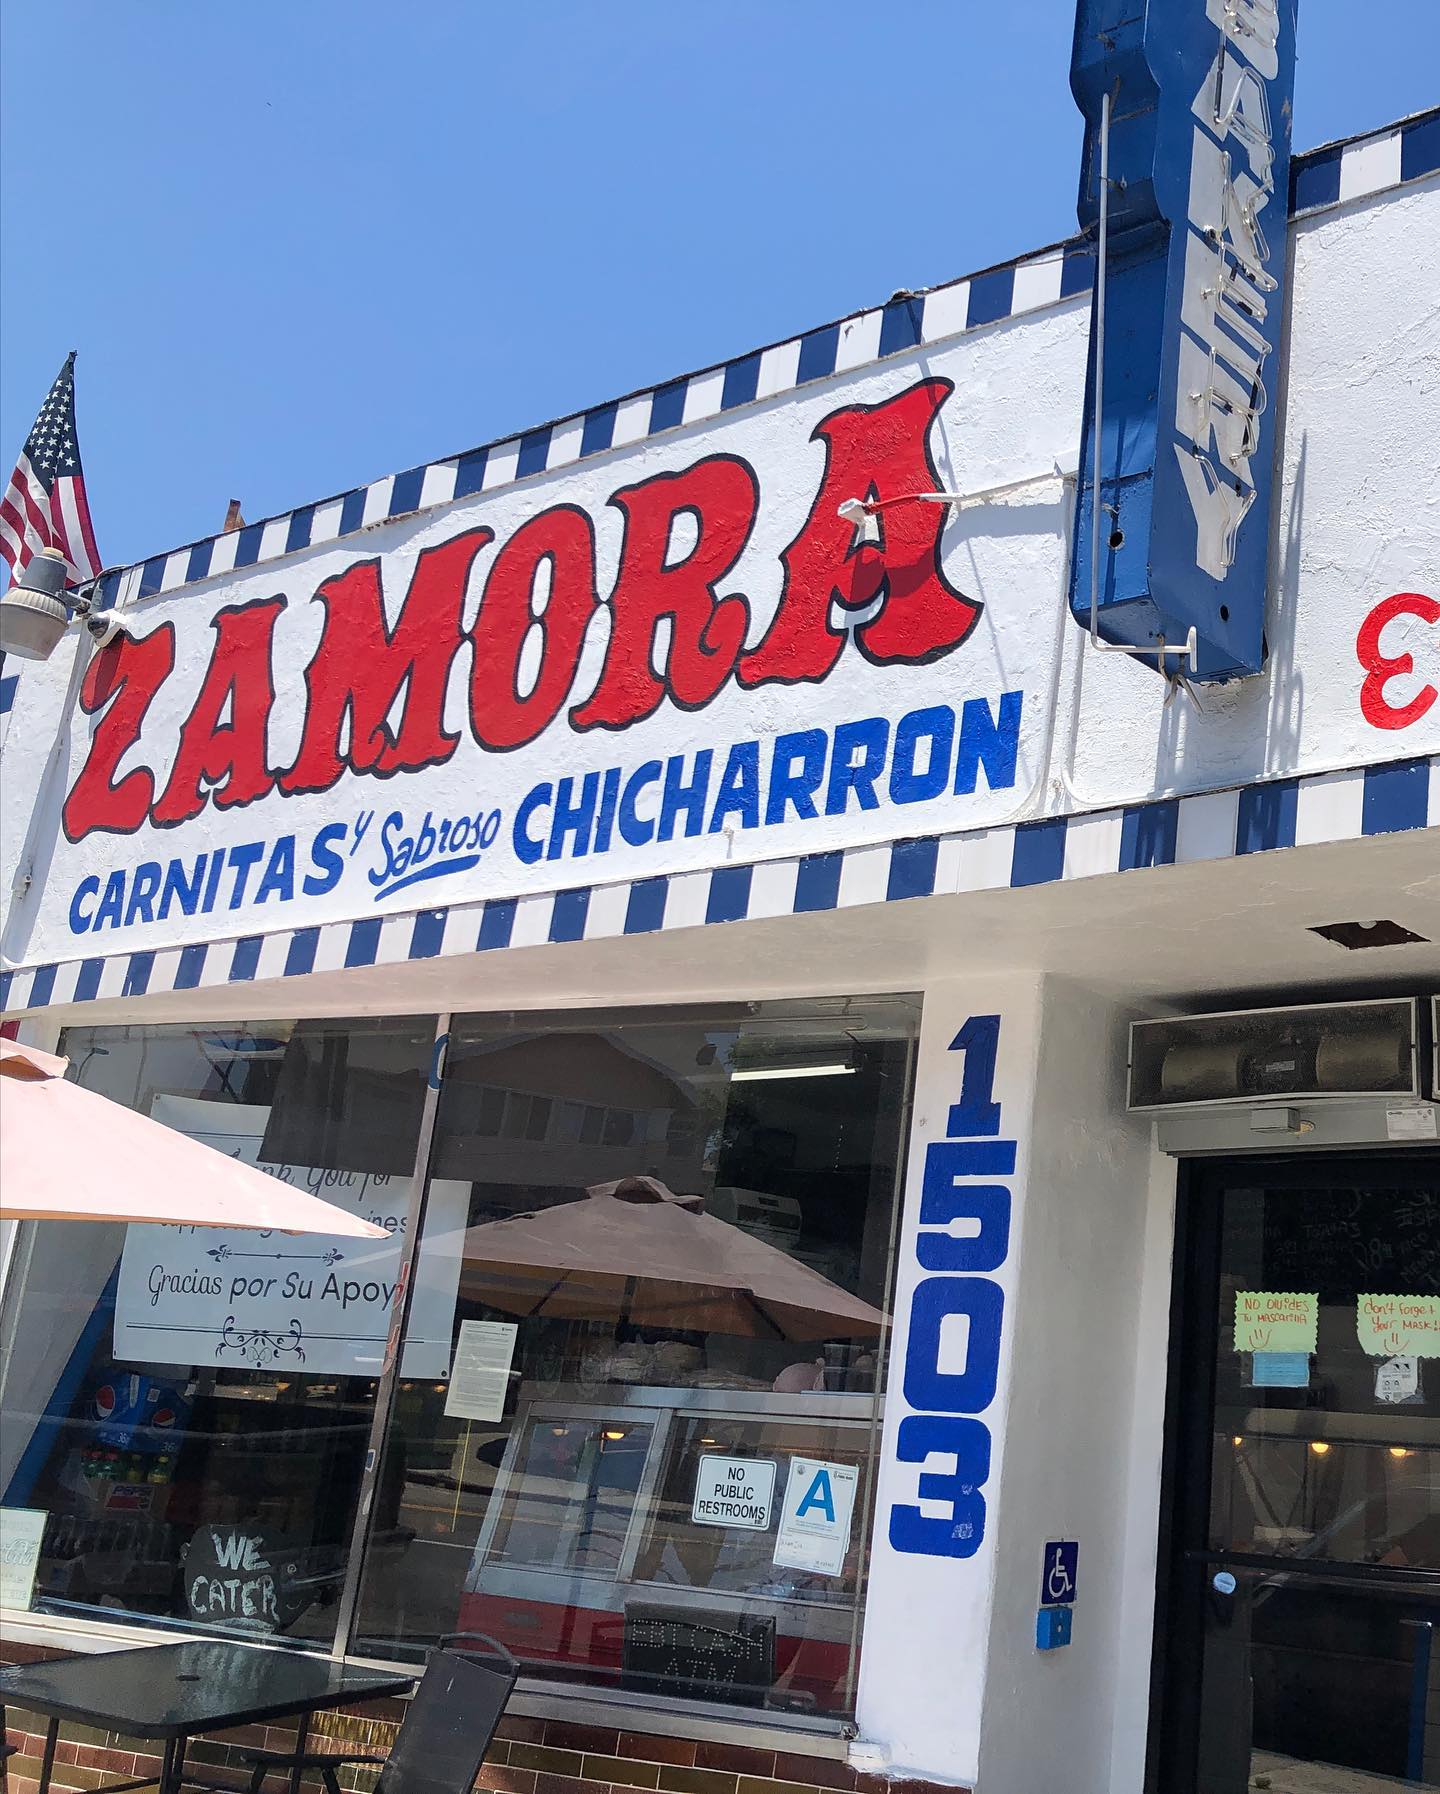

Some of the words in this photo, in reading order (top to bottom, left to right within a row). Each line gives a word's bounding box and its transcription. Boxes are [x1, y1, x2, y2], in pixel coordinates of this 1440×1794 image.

[61, 376, 984, 845] ZAMORA
[69, 821, 349, 935] CARNITAS
[367, 807, 502, 888] Sabroso
[512, 689, 1023, 866] CHICHARRON
[148, 1264, 223, 1307] Gracias
[230, 1276, 278, 1305] por
[281, 1271, 313, 1300] Su
[320, 1272, 398, 1312] Apoy
[888, 1014, 1018, 1560] 1503
[713, 1483, 755, 1501] PUBLIC
[727, 1466, 746, 1482] NO
[794, 1468, 836, 1523] A
[697, 1499, 766, 1520] RESTROOMS
[210, 1528, 272, 1571] WE
[191, 1574, 281, 1623] CATER
